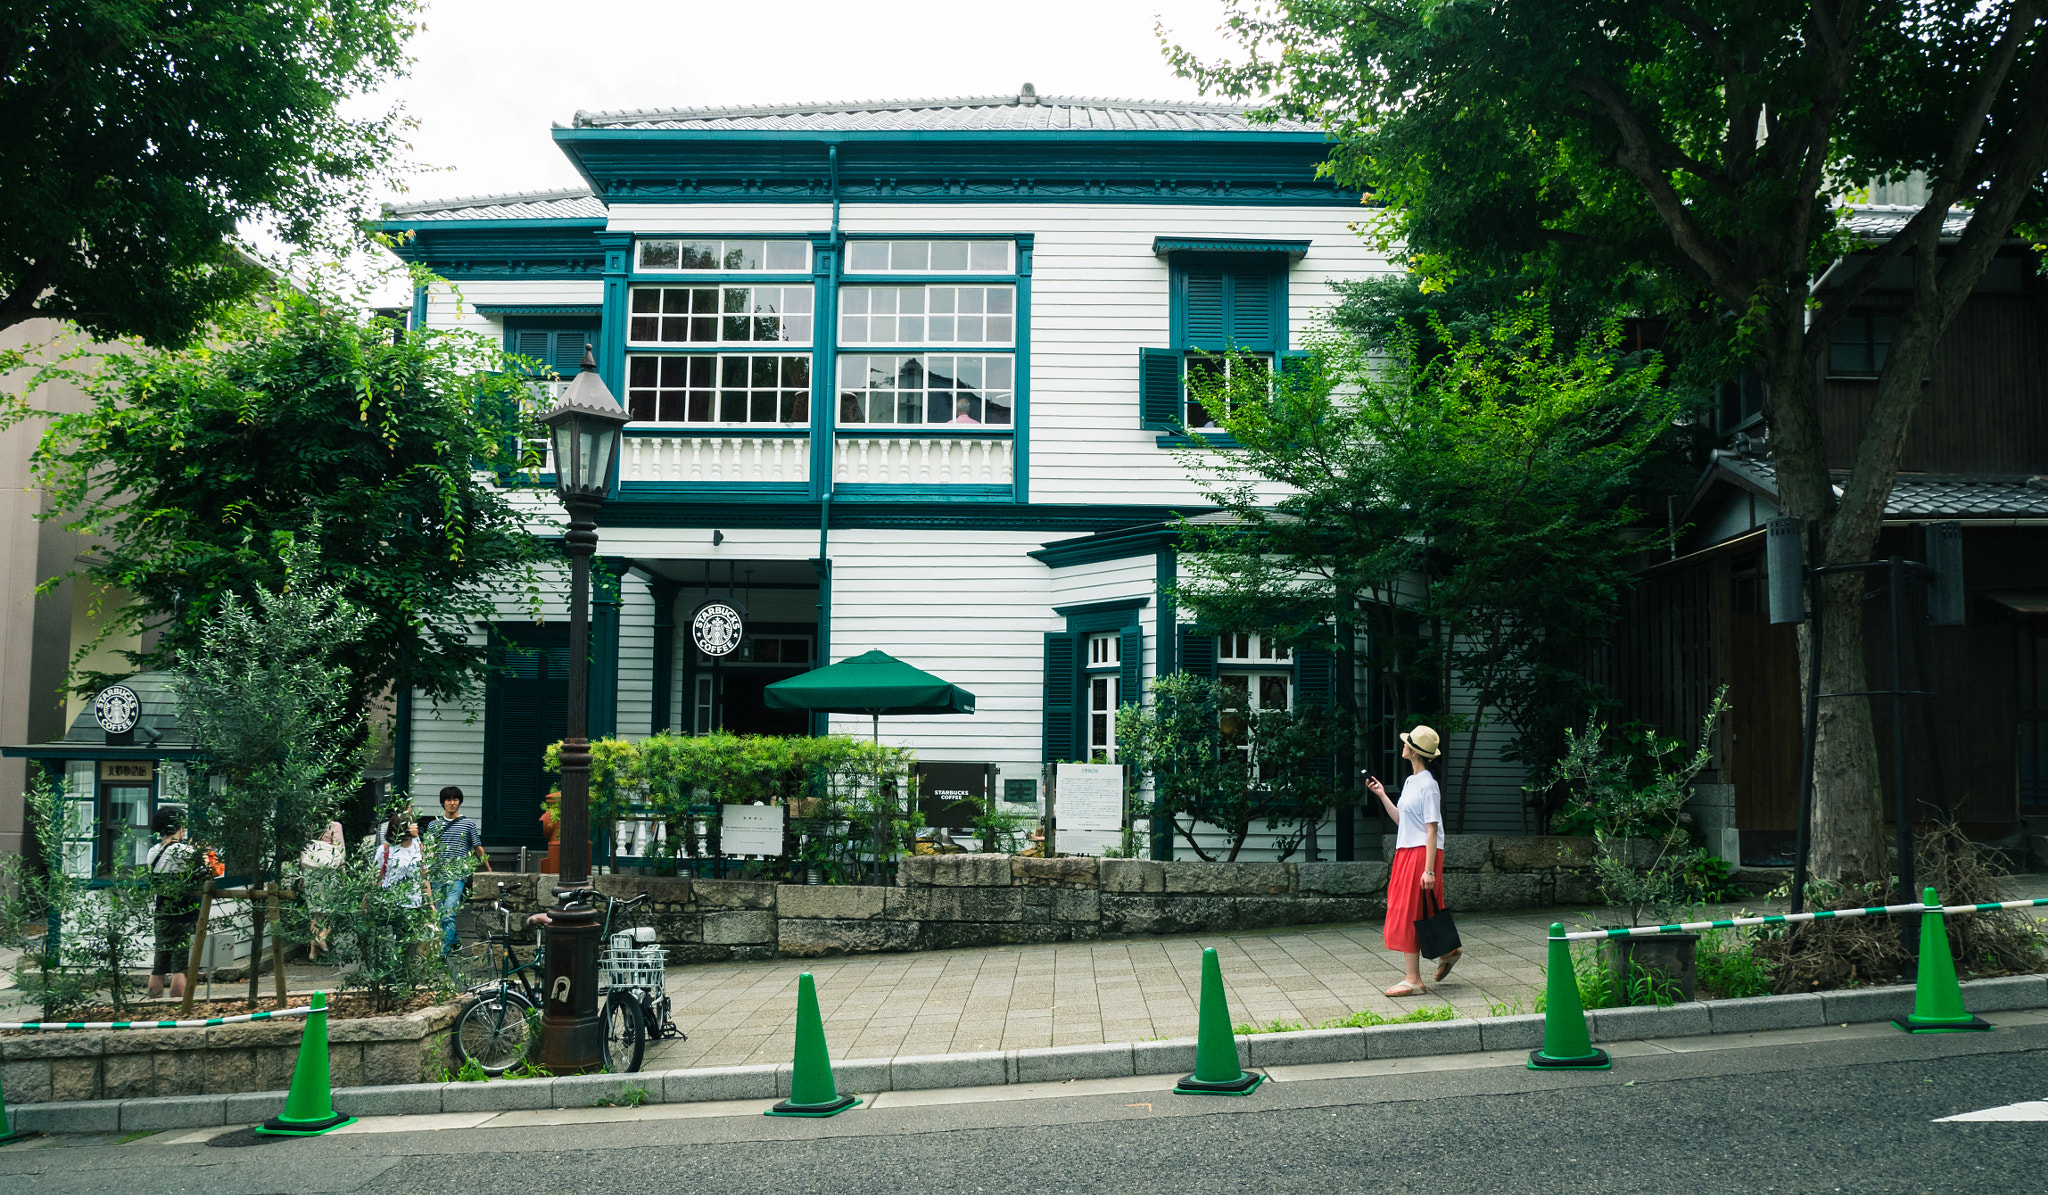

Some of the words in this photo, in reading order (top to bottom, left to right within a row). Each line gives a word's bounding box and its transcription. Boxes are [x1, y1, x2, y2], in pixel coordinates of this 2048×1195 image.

[696, 607, 740, 630] STARBUCKS
[700, 639, 734, 653] COFFEE
[97, 688, 137, 708] STARBUCKS
[101, 718, 132, 731] COFFEE
